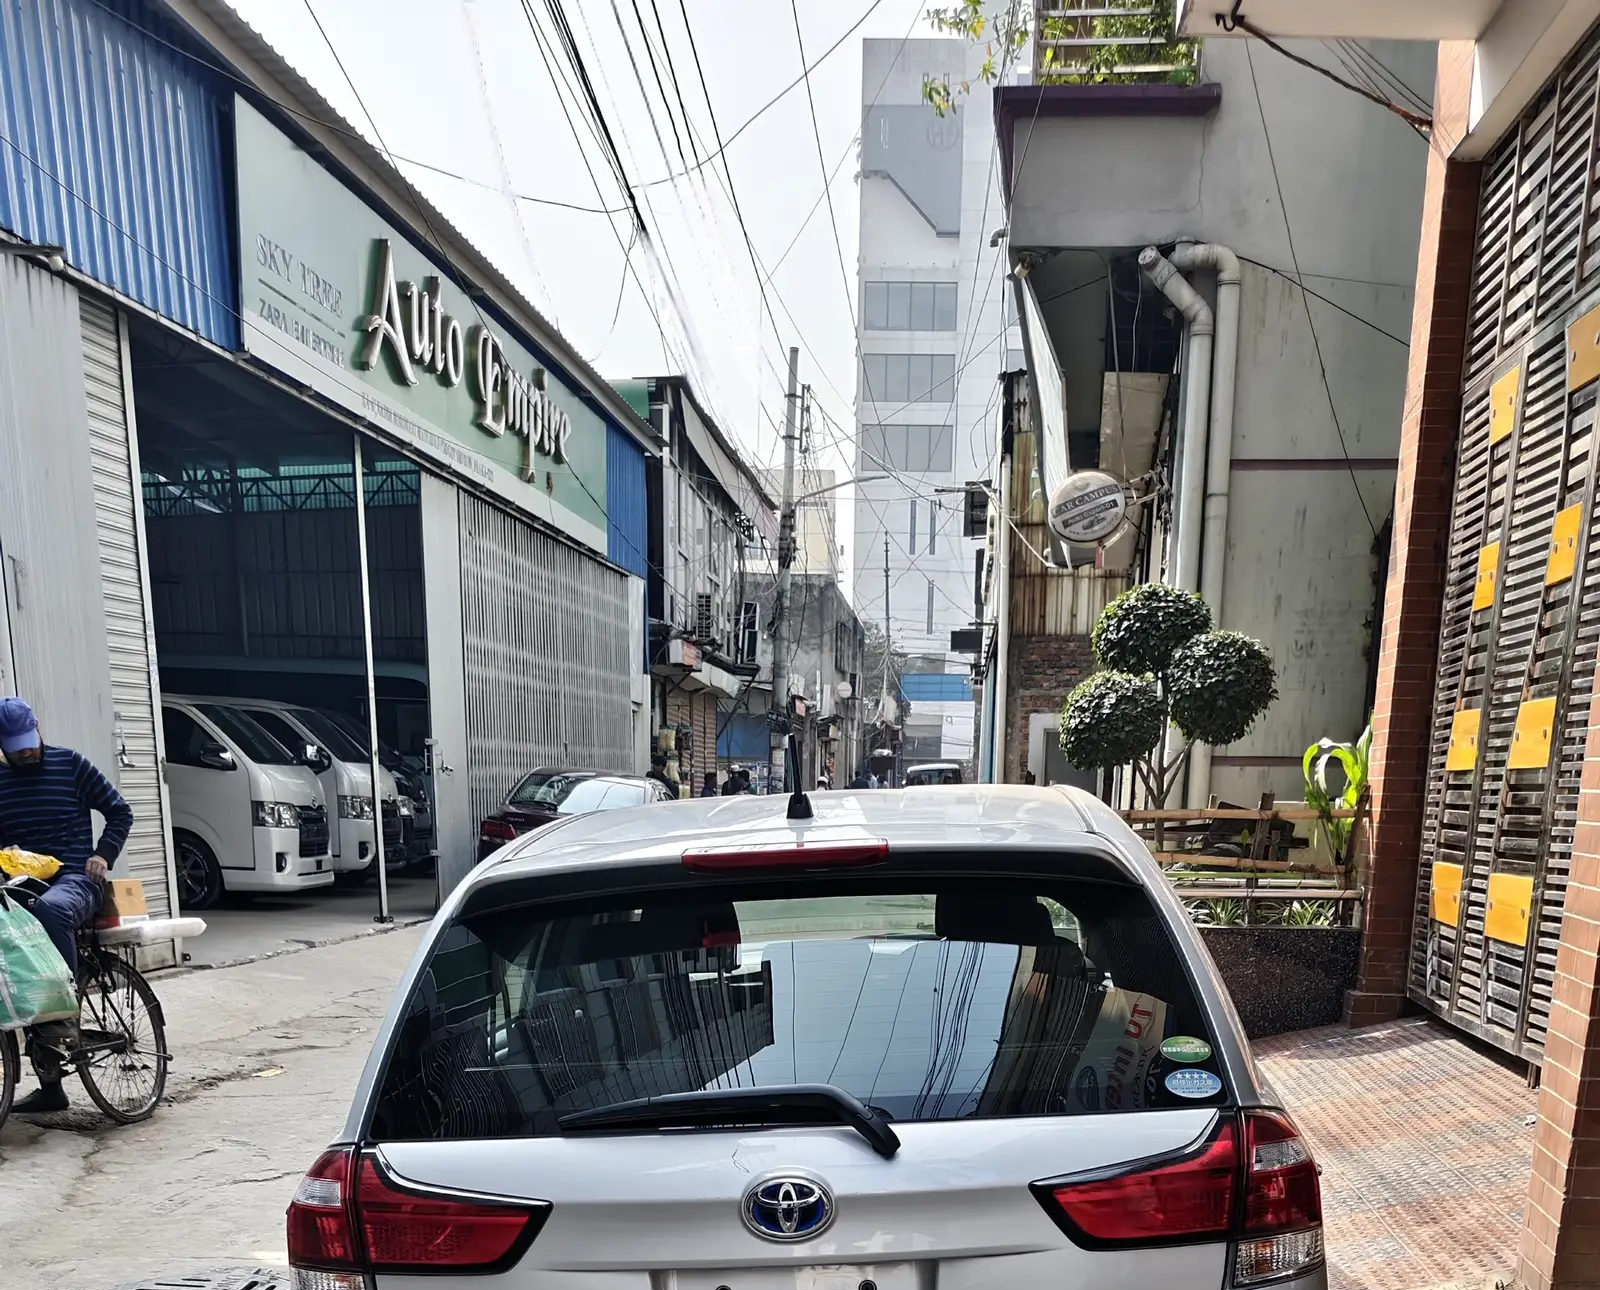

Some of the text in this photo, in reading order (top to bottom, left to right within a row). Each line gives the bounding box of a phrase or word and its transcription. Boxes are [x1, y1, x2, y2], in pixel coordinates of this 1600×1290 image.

[256, 233, 343, 319] SKY TREE
[259, 298, 289, 335] ZARA
[360, 238, 464, 388] Auto
[474, 325, 572, 483] Empire
[1052, 501, 1075, 516] CAR
[1075, 485, 1119, 506] CAMPUS
[1068, 514, 1083, 525] Auto
